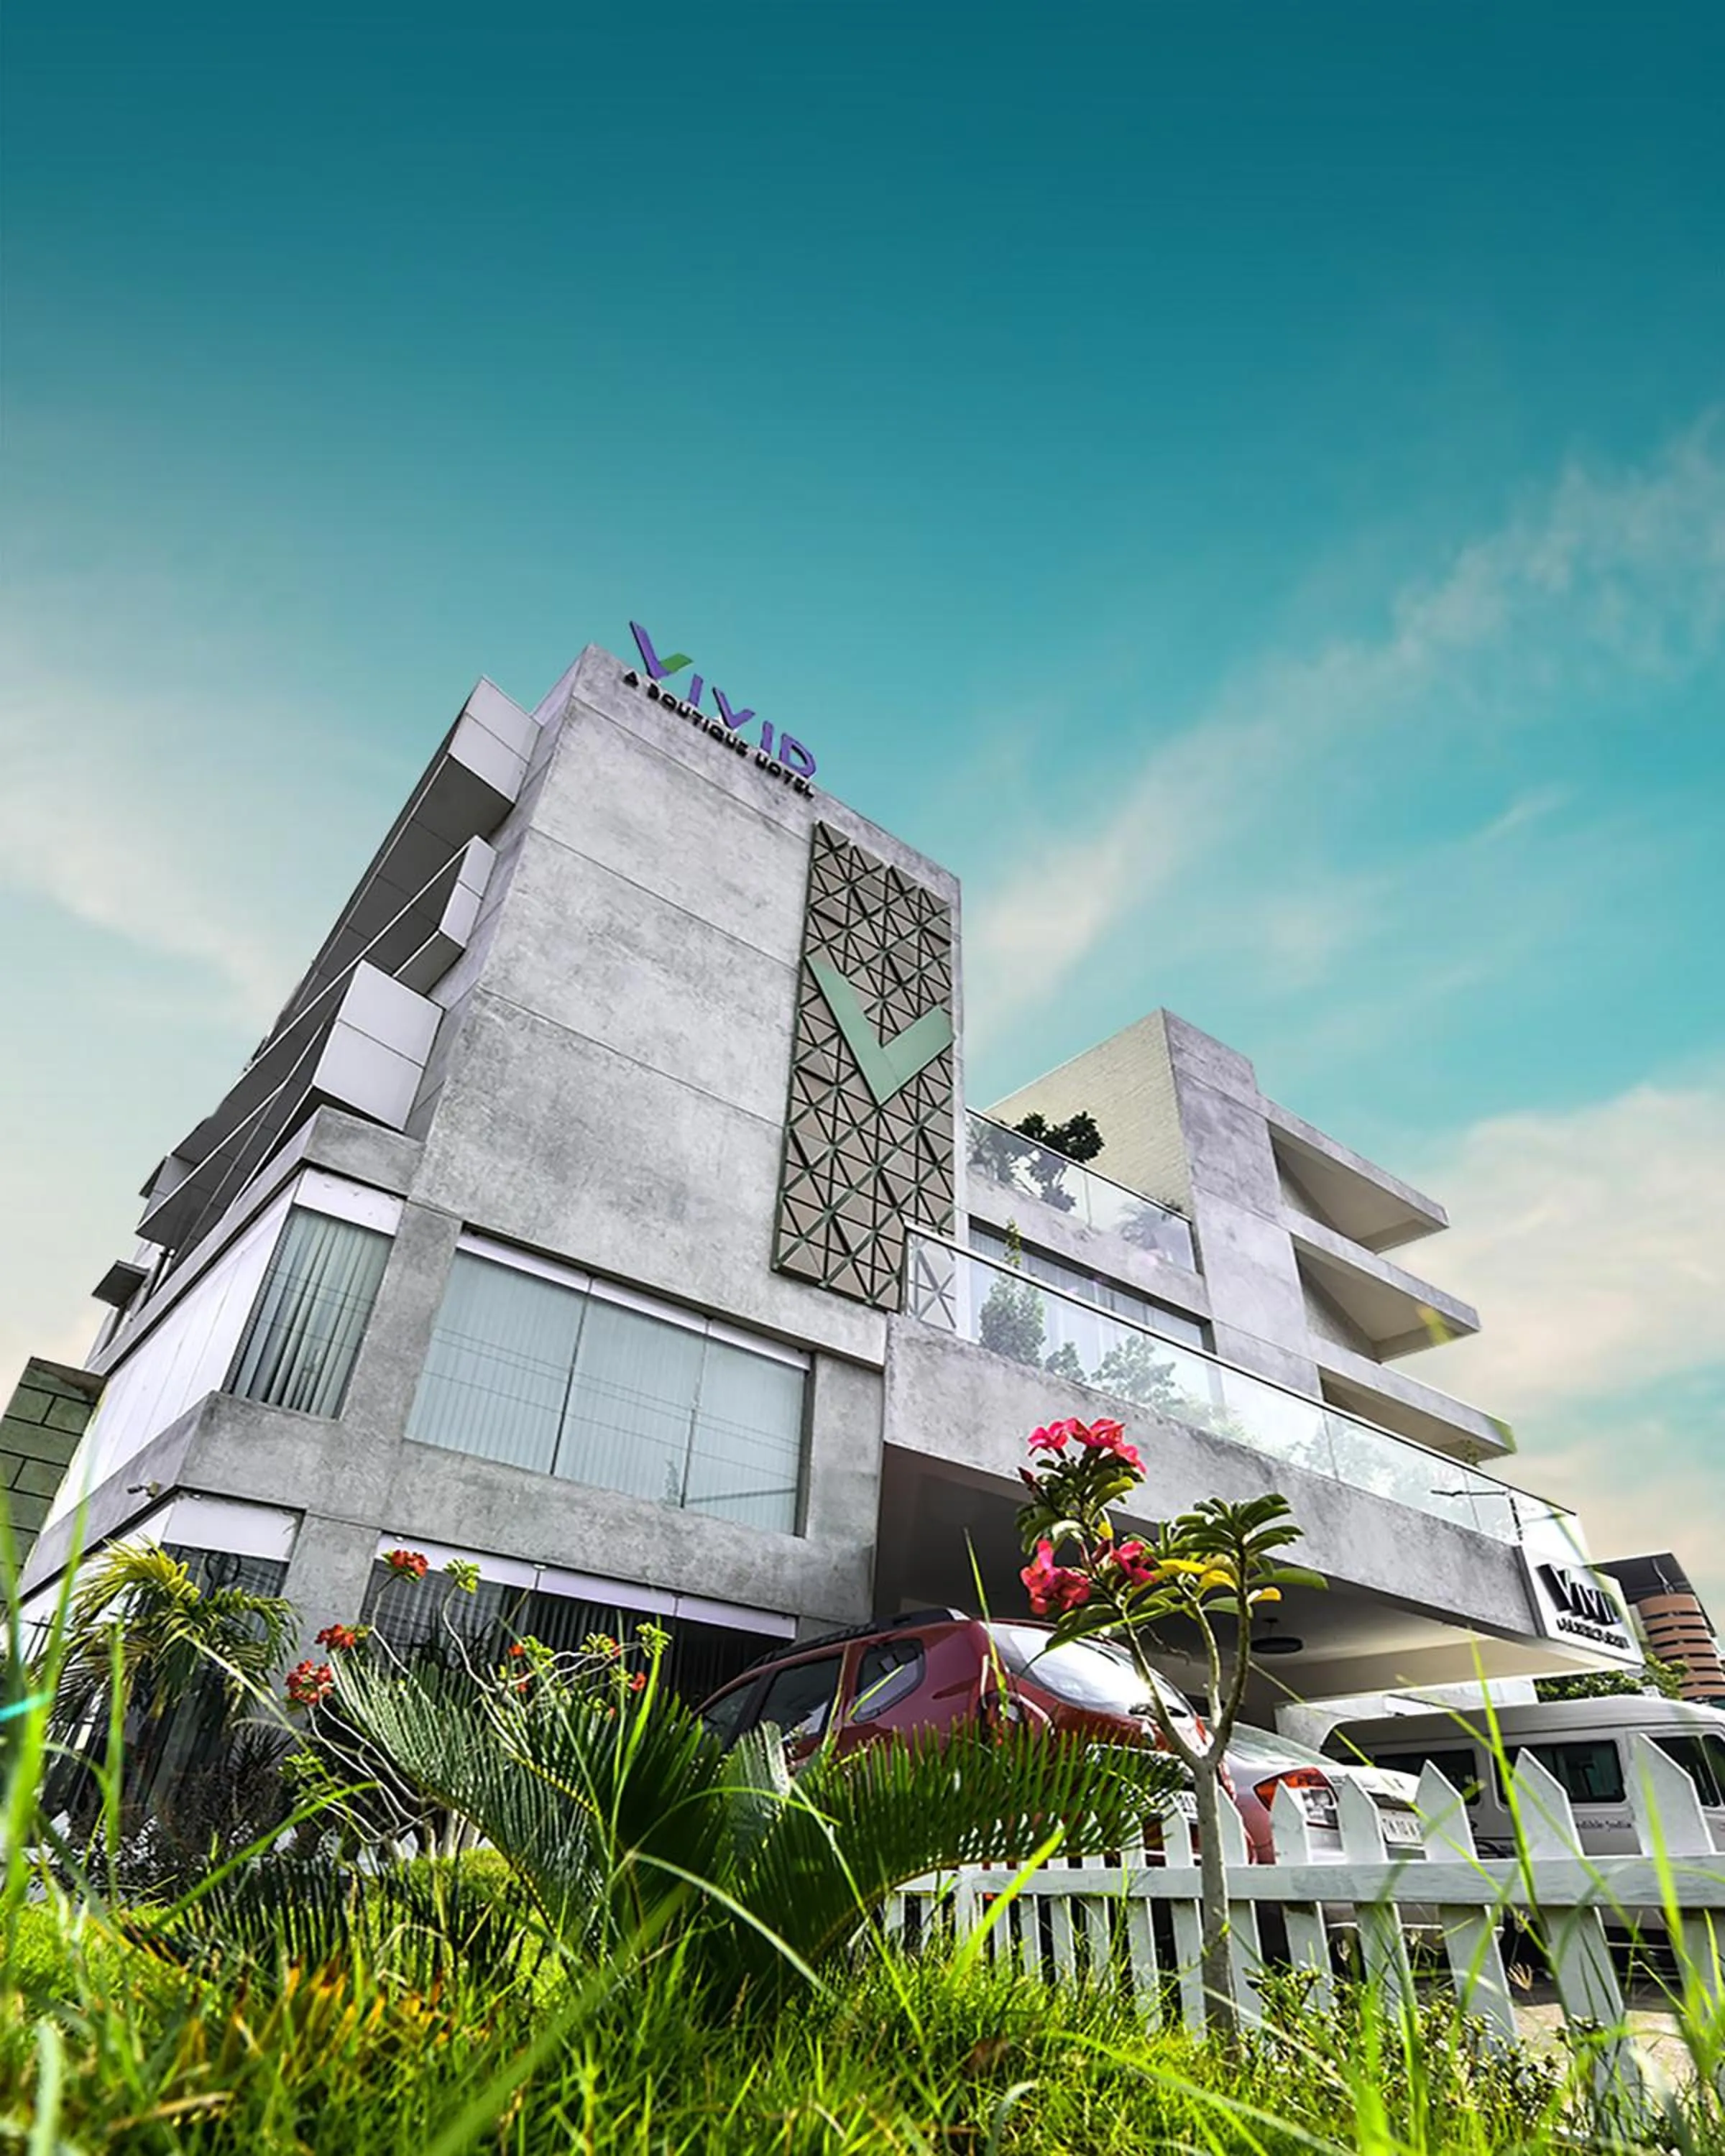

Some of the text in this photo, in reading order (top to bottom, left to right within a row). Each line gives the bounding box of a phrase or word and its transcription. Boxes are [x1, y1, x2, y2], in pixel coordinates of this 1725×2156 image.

[622, 671, 639, 688] A
[647, 683, 749, 757] BOUTIQUE
[629, 620, 816, 778] VIVID
